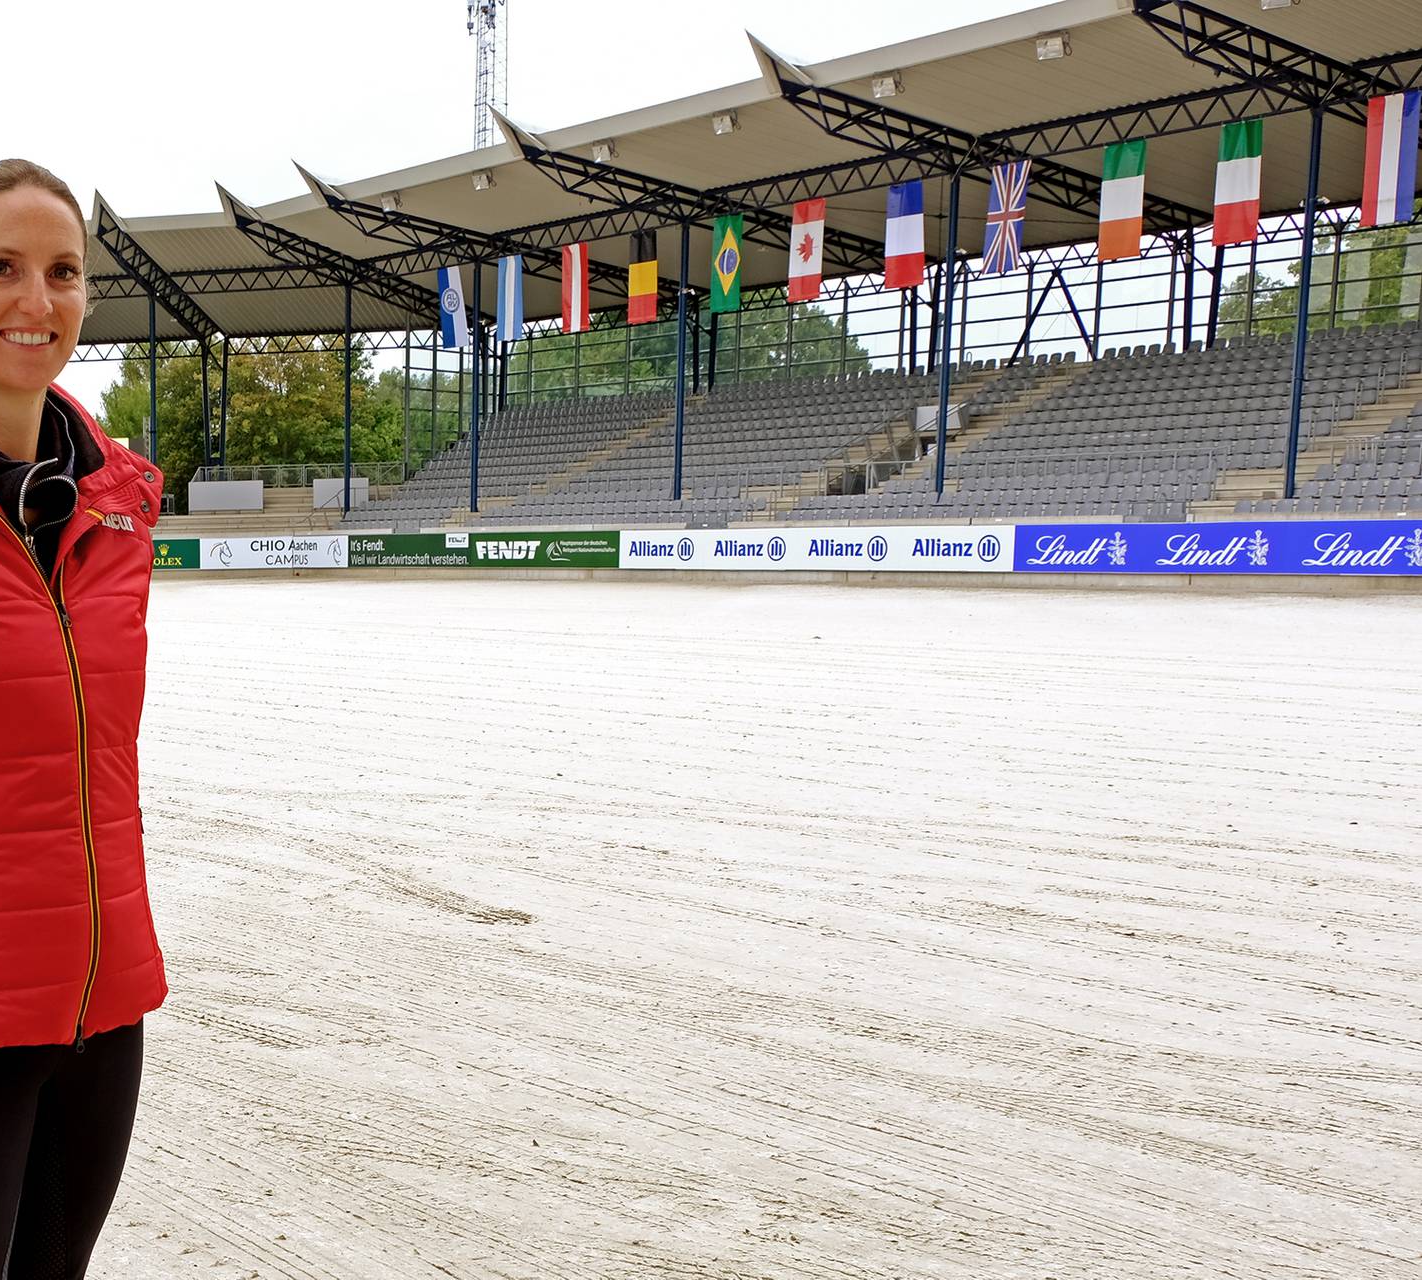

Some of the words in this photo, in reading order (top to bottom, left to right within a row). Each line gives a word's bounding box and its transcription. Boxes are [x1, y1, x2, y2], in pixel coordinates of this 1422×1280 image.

[250, 540, 285, 552] CHIO
[289, 539, 318, 551] Aachen
[476, 541, 541, 559] FENDT
[629, 541, 674, 557] Allianz
[714, 540, 764, 557] Allianz
[808, 539, 863, 557] Allianz
[912, 538, 973, 557] Allianz
[1026, 534, 1108, 566] Lindt
[1155, 533, 1247, 567] Lindt
[1301, 532, 1406, 567] Lindt
[153, 557, 182, 566] OLEX
[265, 553, 308, 565] CAMPUS
[351, 554, 365, 565] Weil
[366, 554, 377, 565] wir
[378, 553, 430, 565] Landwirtschaft
